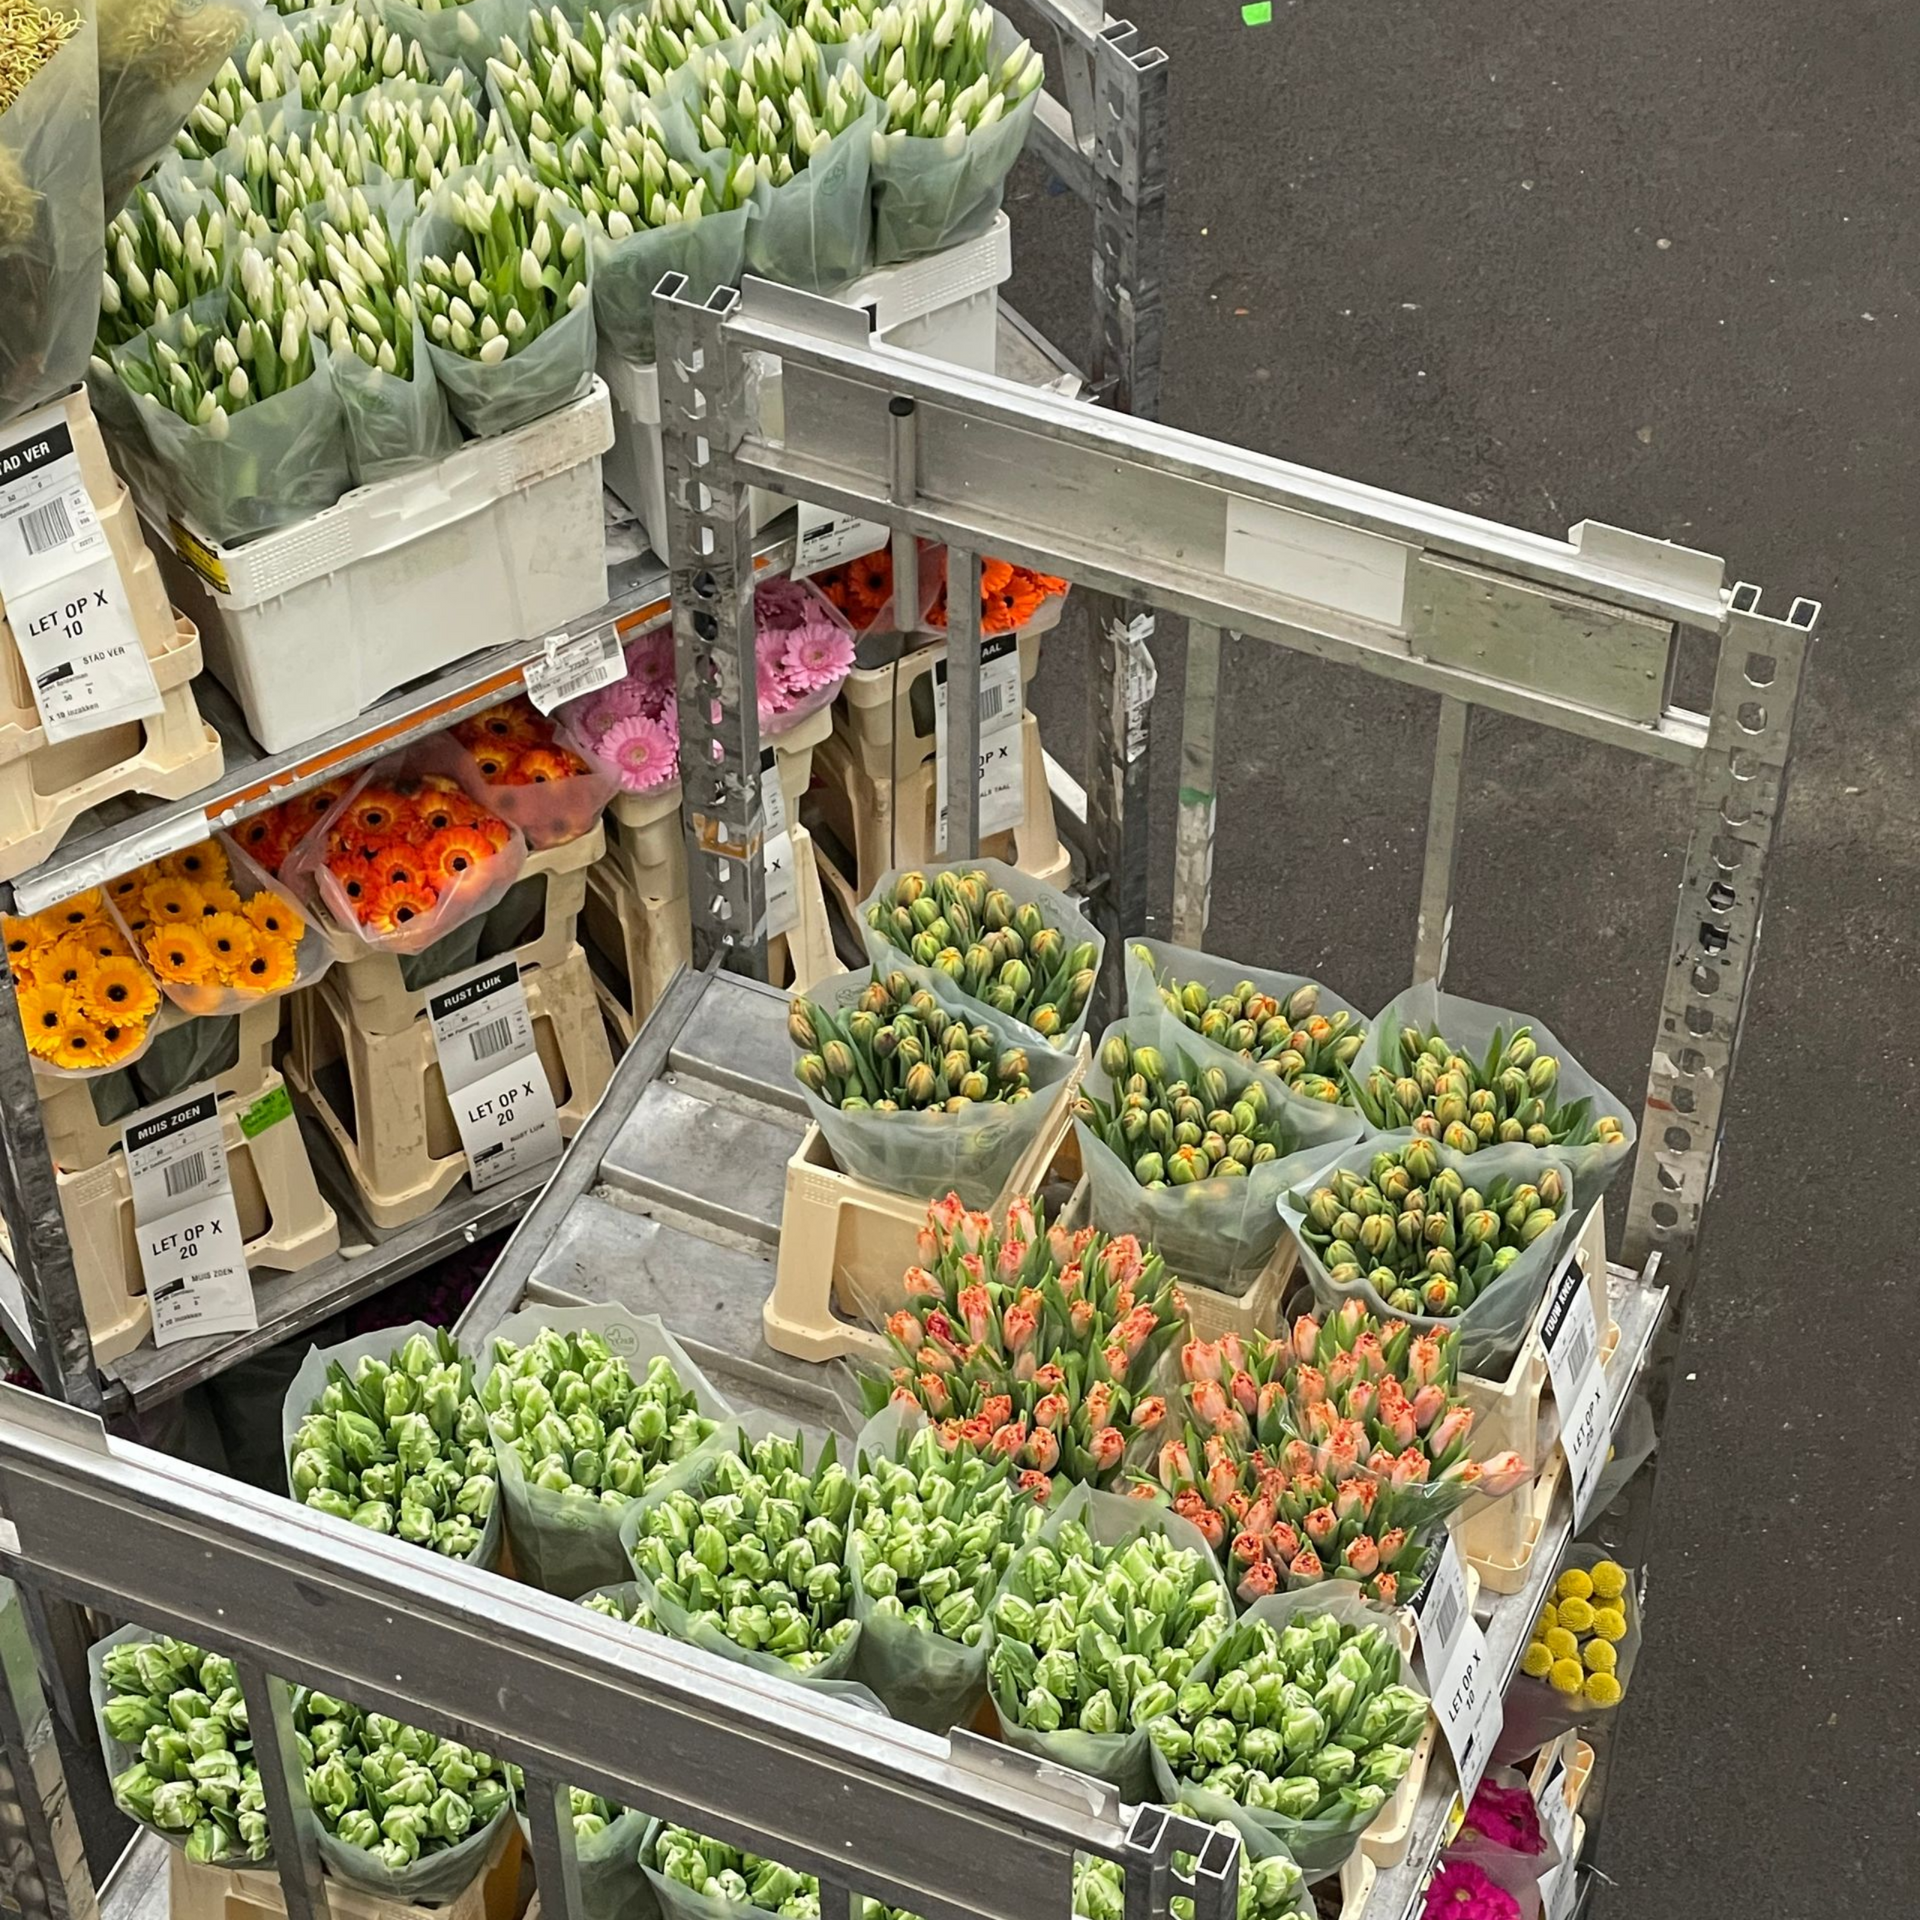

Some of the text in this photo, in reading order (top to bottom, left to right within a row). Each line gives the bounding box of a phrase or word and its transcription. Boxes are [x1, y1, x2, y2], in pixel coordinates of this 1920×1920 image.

[23, 441, 51, 463] VER
[29, 589, 109, 636] LET OP X
[62, 620, 83, 638] 10
[83, 646, 126, 665] STAD VER
[982, 643, 1002, 657] AAL
[999, 745, 1008, 759] X
[772, 858, 781, 872] X
[443, 974, 502, 1008] RUST LUIK
[468, 1081, 535, 1123] LET OP X
[137, 1105, 201, 1141] MUIS ZOEN
[497, 1109, 515, 1127] 20
[152, 1220, 222, 1256] LET OP X
[179, 1243, 198, 1260] 20
[191, 1268, 233, 1282] MUIS ZOEN
[1544, 1275, 1575, 1337] TOUW KNEL
[1573, 1387, 1601, 1455] LET OP X
[1448, 1649, 1481, 1723] LET OP X
[1465, 1689, 1475, 1711] 10
